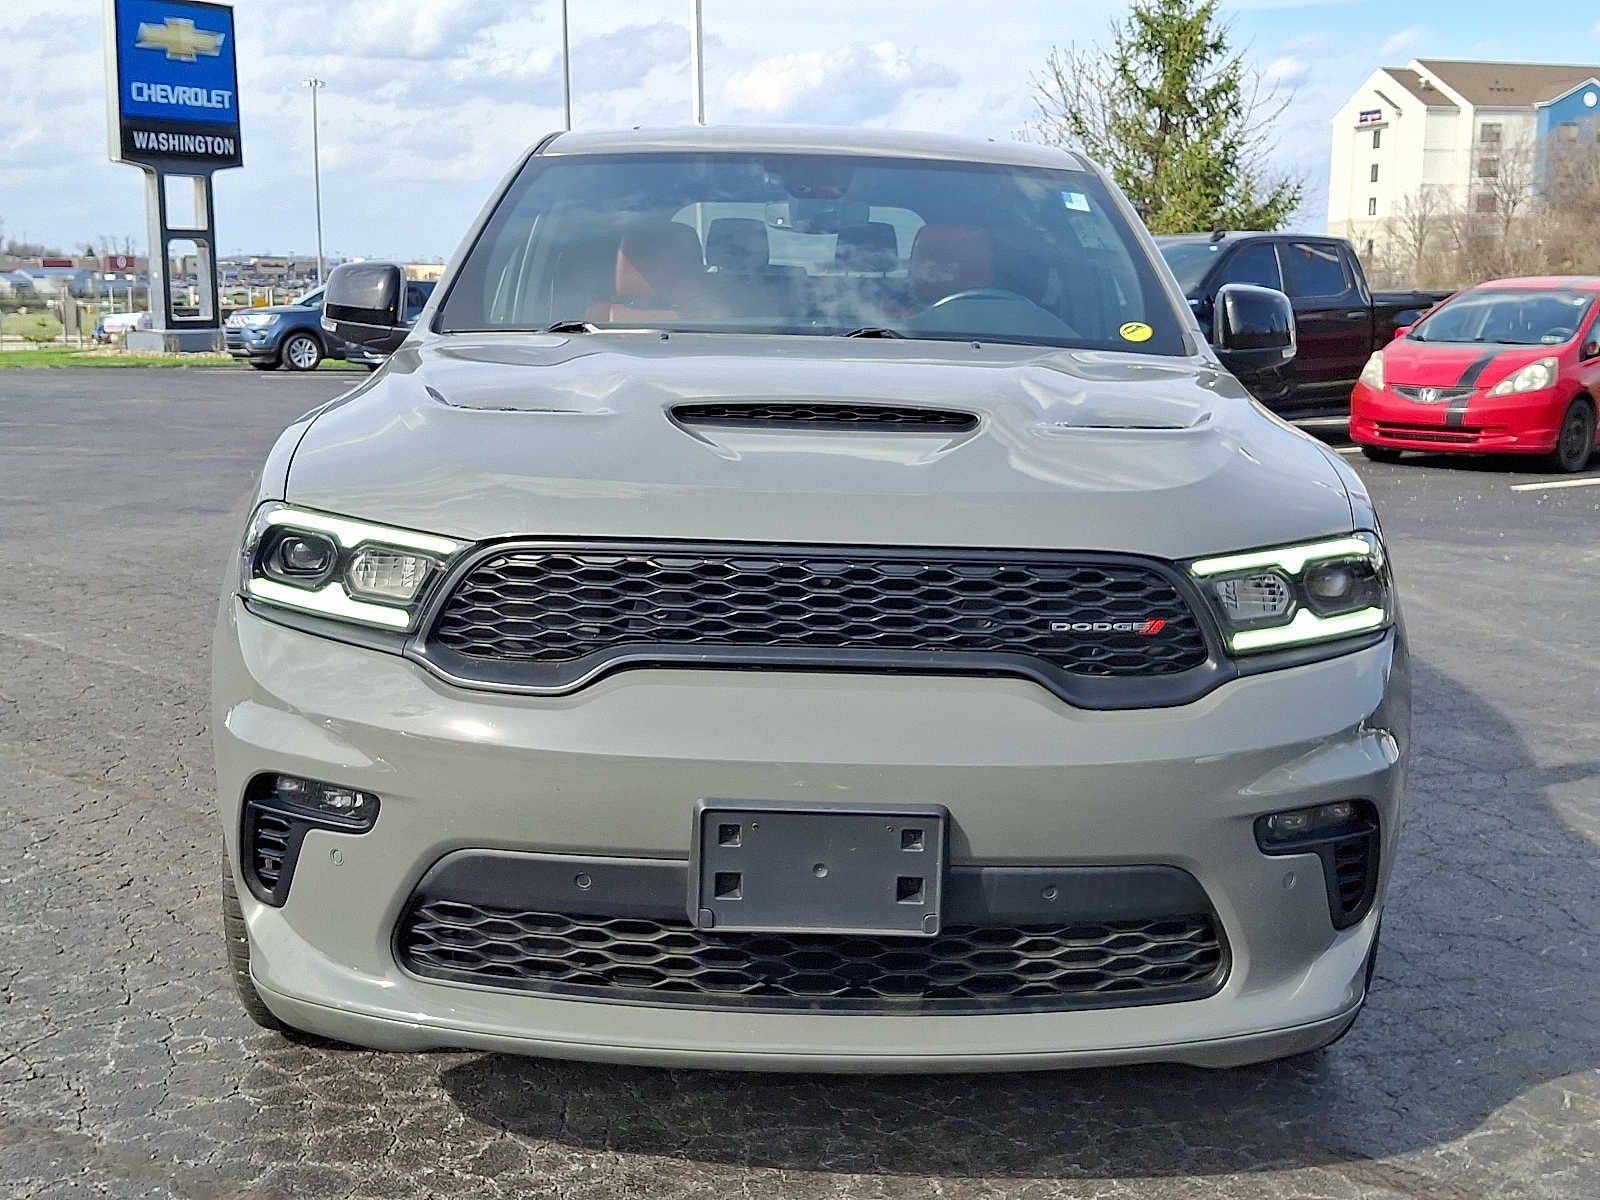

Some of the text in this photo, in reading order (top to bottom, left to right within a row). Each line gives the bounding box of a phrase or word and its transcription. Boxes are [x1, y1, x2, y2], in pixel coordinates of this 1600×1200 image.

[131, 81, 233, 109] CHEVROLET
[132, 130, 235, 156] WASHINGTON
[1051, 621, 1149, 632] DODGE
